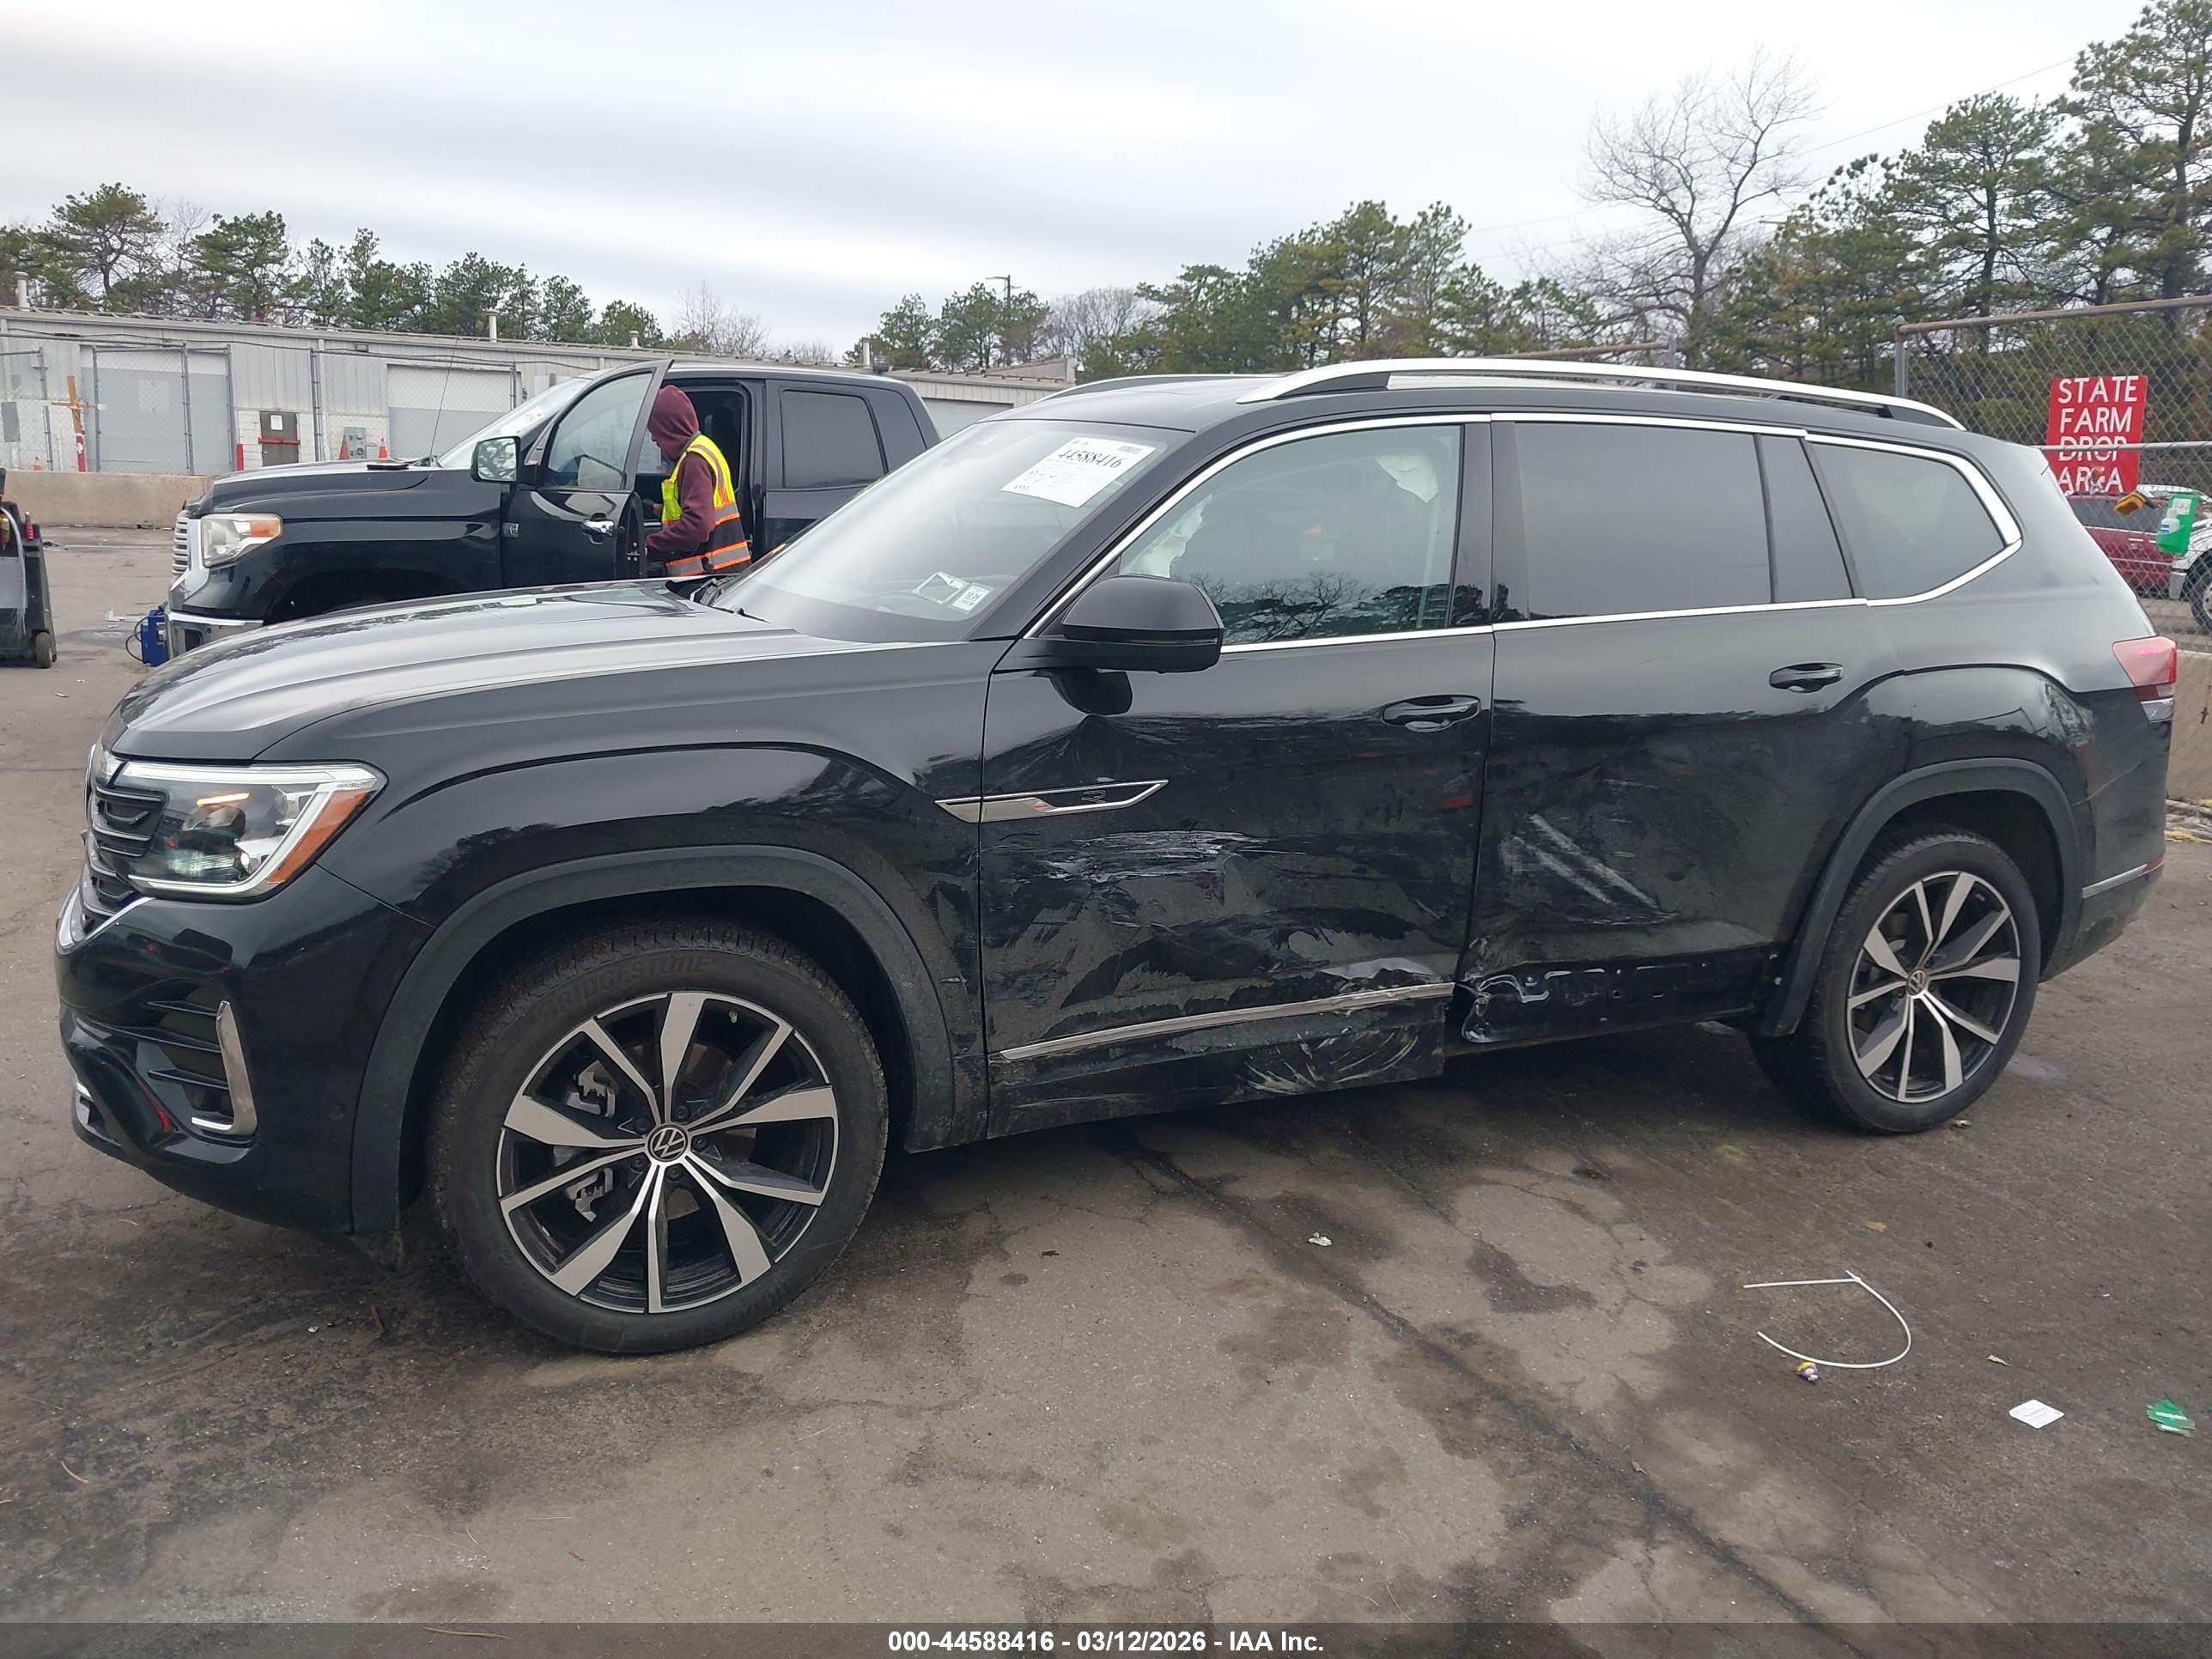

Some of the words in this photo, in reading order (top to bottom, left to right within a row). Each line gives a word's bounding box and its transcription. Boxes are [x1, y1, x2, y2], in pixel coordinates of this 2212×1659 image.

[2057, 375, 2140, 404] STATE
[2059, 406, 2132, 434] FARM
[1057, 448, 1125, 469] 44588416
[2057, 435, 2127, 462] DROP
[651, 1126, 688, 1162] VW
